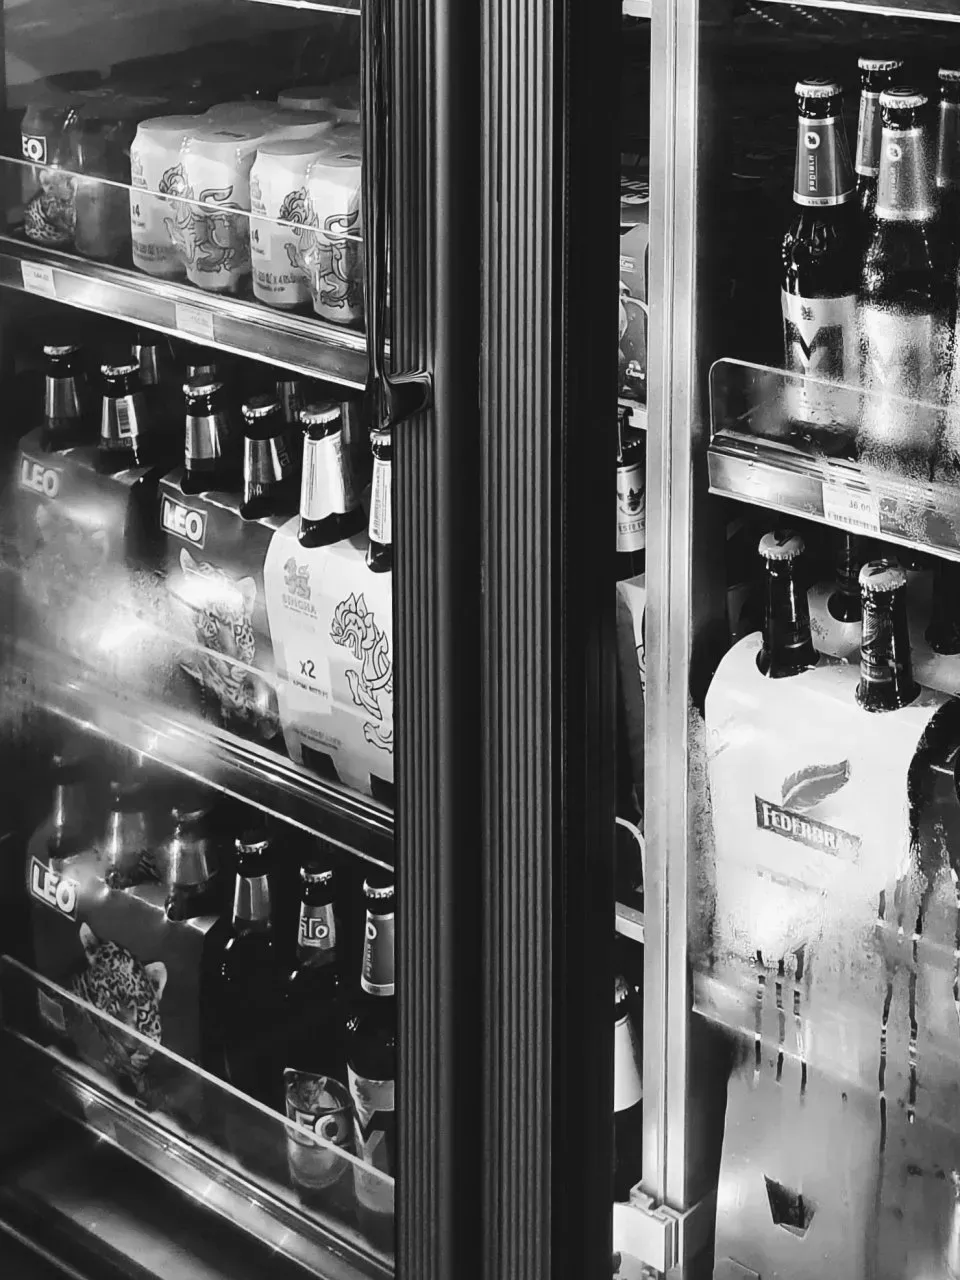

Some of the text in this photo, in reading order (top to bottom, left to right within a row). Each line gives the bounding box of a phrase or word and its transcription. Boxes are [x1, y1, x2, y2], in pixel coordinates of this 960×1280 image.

[21, 459, 60, 497] LEO
[299, 659, 318, 680] x2
[32, 863, 77, 914] LEO
